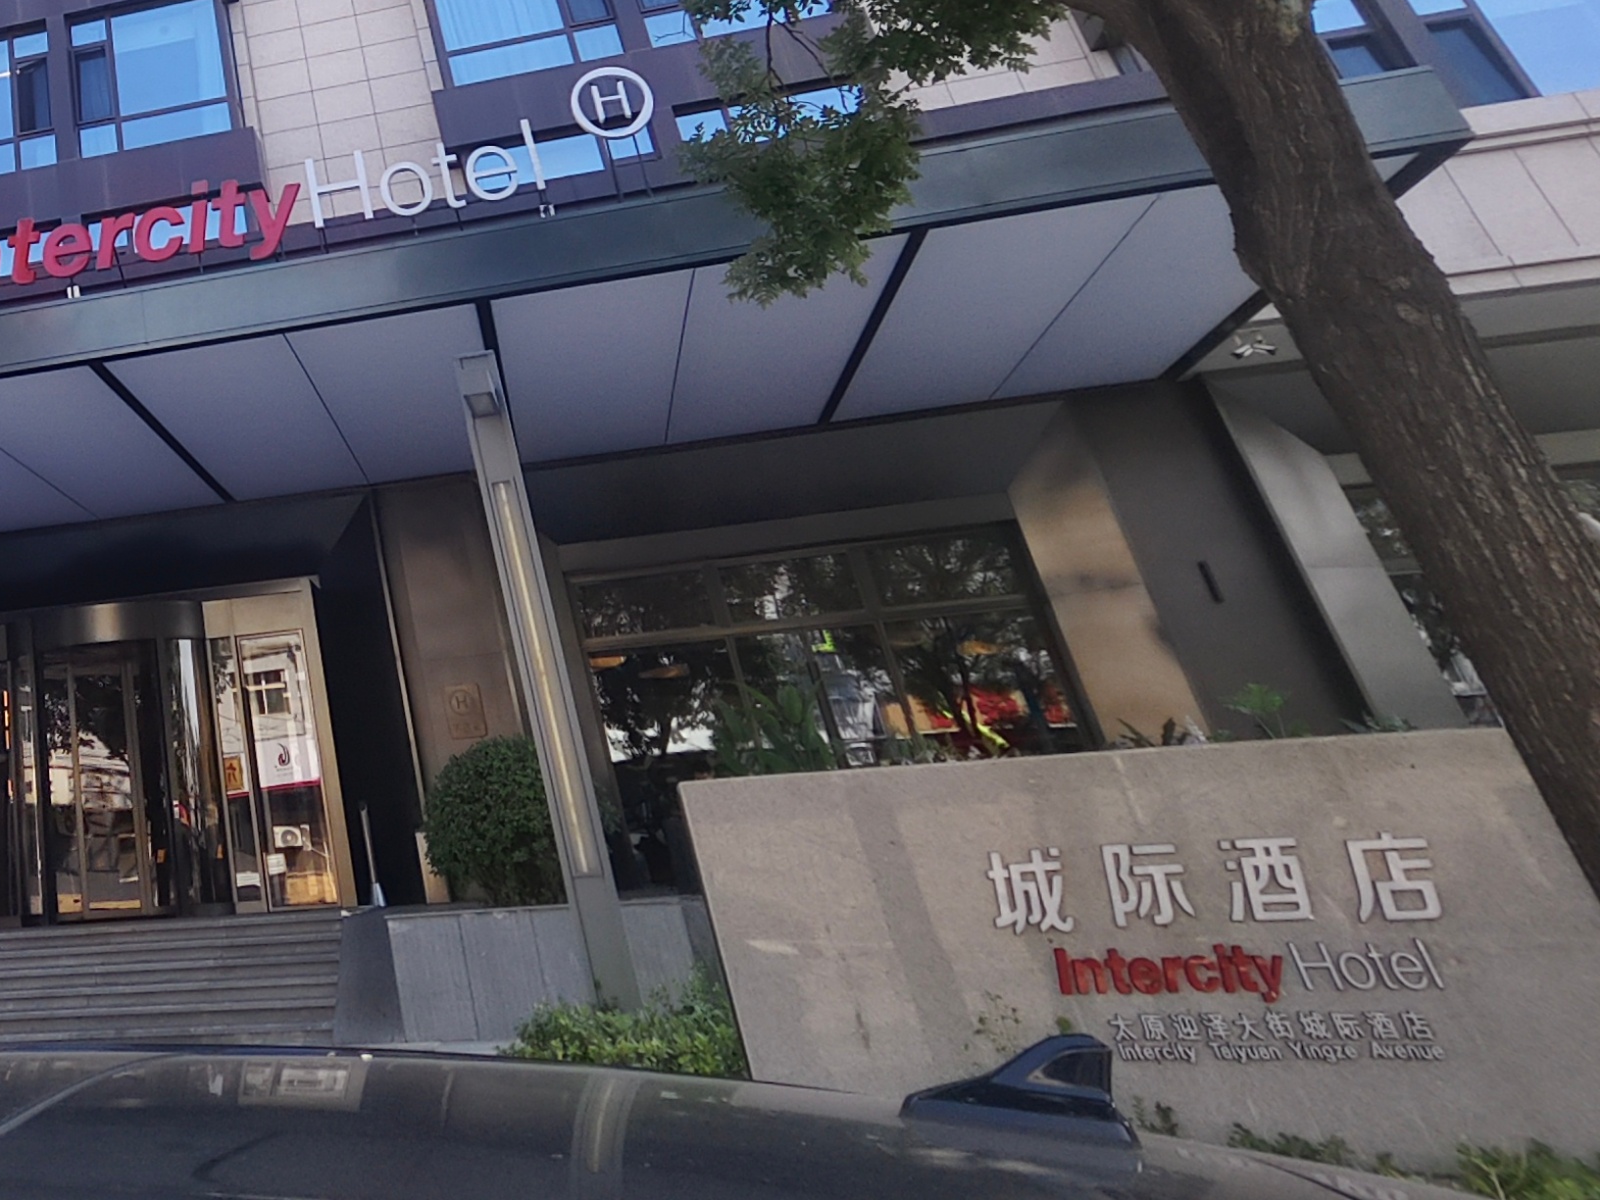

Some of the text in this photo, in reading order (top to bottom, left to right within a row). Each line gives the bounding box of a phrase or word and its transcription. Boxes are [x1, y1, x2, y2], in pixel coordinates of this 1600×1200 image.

[304, 119, 548, 228] Hotel
[987, 831, 1443, 935] 城际酒店
[1053, 937, 1446, 1003] Intercity Hotel
[1108, 1010, 1436, 1042] 太原迎泽大街城际酒店
[1115, 1041, 1197, 1064] Intercity
[1210, 1041, 1283, 1064] Taiyuan
[1369, 1040, 1447, 1062] Avenue
